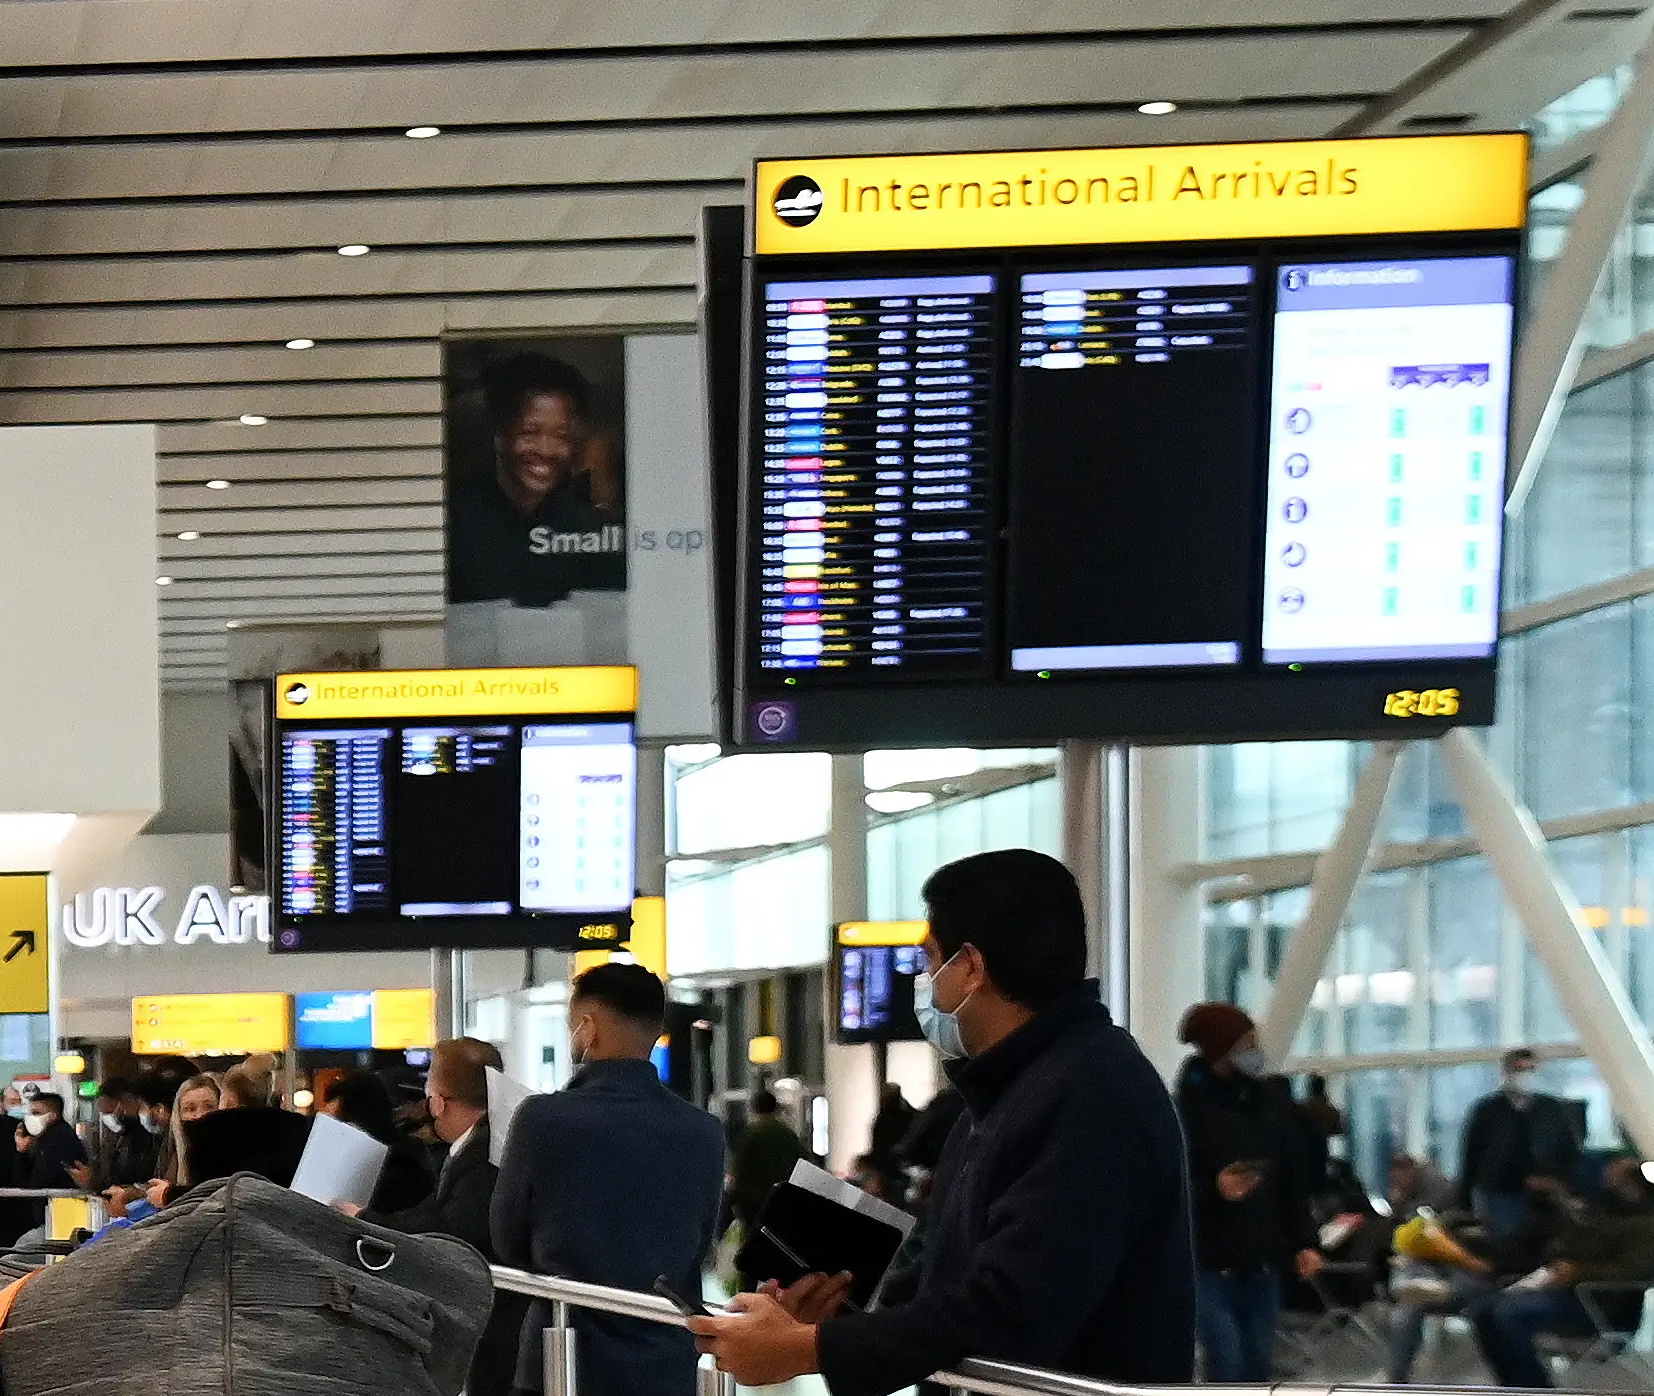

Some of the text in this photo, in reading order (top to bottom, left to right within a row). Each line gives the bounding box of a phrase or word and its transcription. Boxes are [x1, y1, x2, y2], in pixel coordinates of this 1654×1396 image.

[839, 158, 1360, 214] International Arrivals
[1308, 267, 1424, 287] Information
[528, 524, 623, 554] Small
[666, 529, 704, 556] op
[316, 676, 560, 701] International Arrivals
[1383, 688, 1460, 718] 12:05
[62, 885, 166, 948] UK
[578, 924, 616, 940] 12:05
